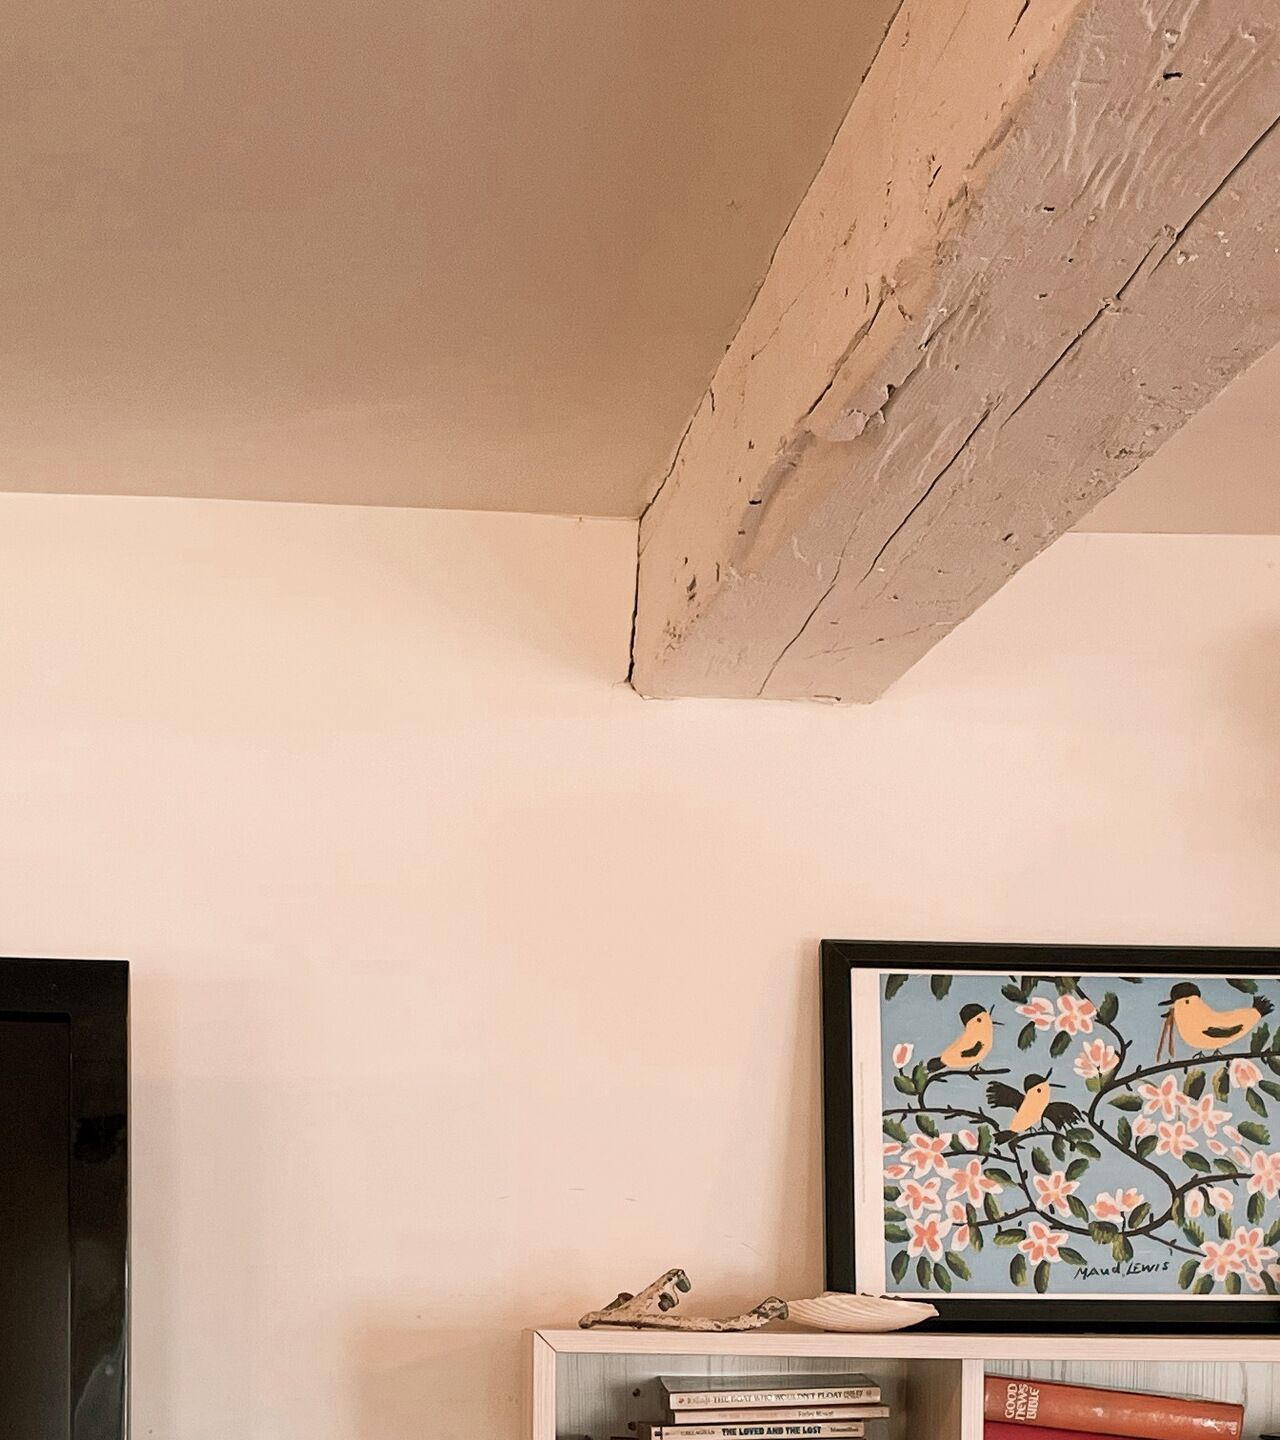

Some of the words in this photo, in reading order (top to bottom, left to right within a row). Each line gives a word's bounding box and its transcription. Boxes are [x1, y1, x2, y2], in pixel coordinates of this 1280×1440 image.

[1126, 1261, 1169, 1275] LEWIS
[1005, 1383, 1018, 1418] GOOD
[1027, 1387, 1039, 1420] BIBLE
